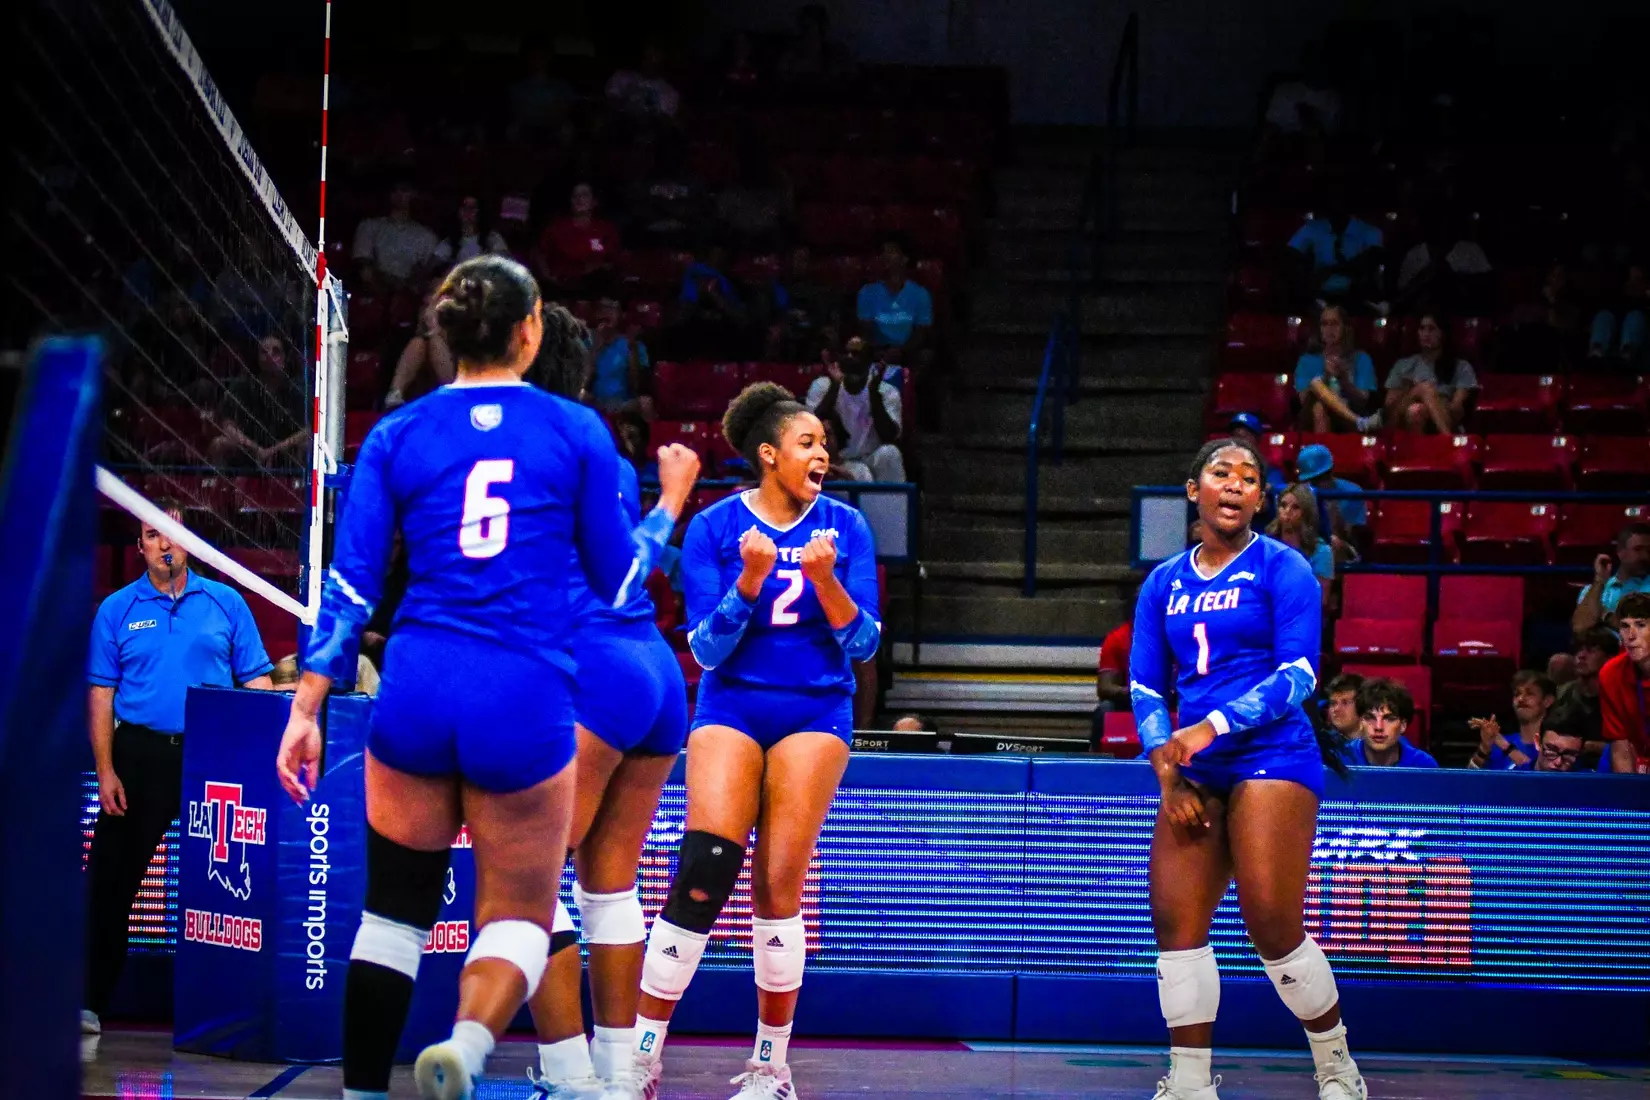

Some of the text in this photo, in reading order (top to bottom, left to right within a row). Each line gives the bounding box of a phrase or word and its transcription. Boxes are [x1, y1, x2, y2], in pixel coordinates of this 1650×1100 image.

[459, 459, 514, 559] 6
[770, 569, 804, 625] 2
[1166, 587, 1240, 615] LA TECH
[1193, 622, 1209, 675] 1
[188, 801, 213, 838] LA
[302, 803, 330, 990] sports imports
[185, 908, 262, 952] BULLDOGS
[423, 920, 470, 954] DOGS
